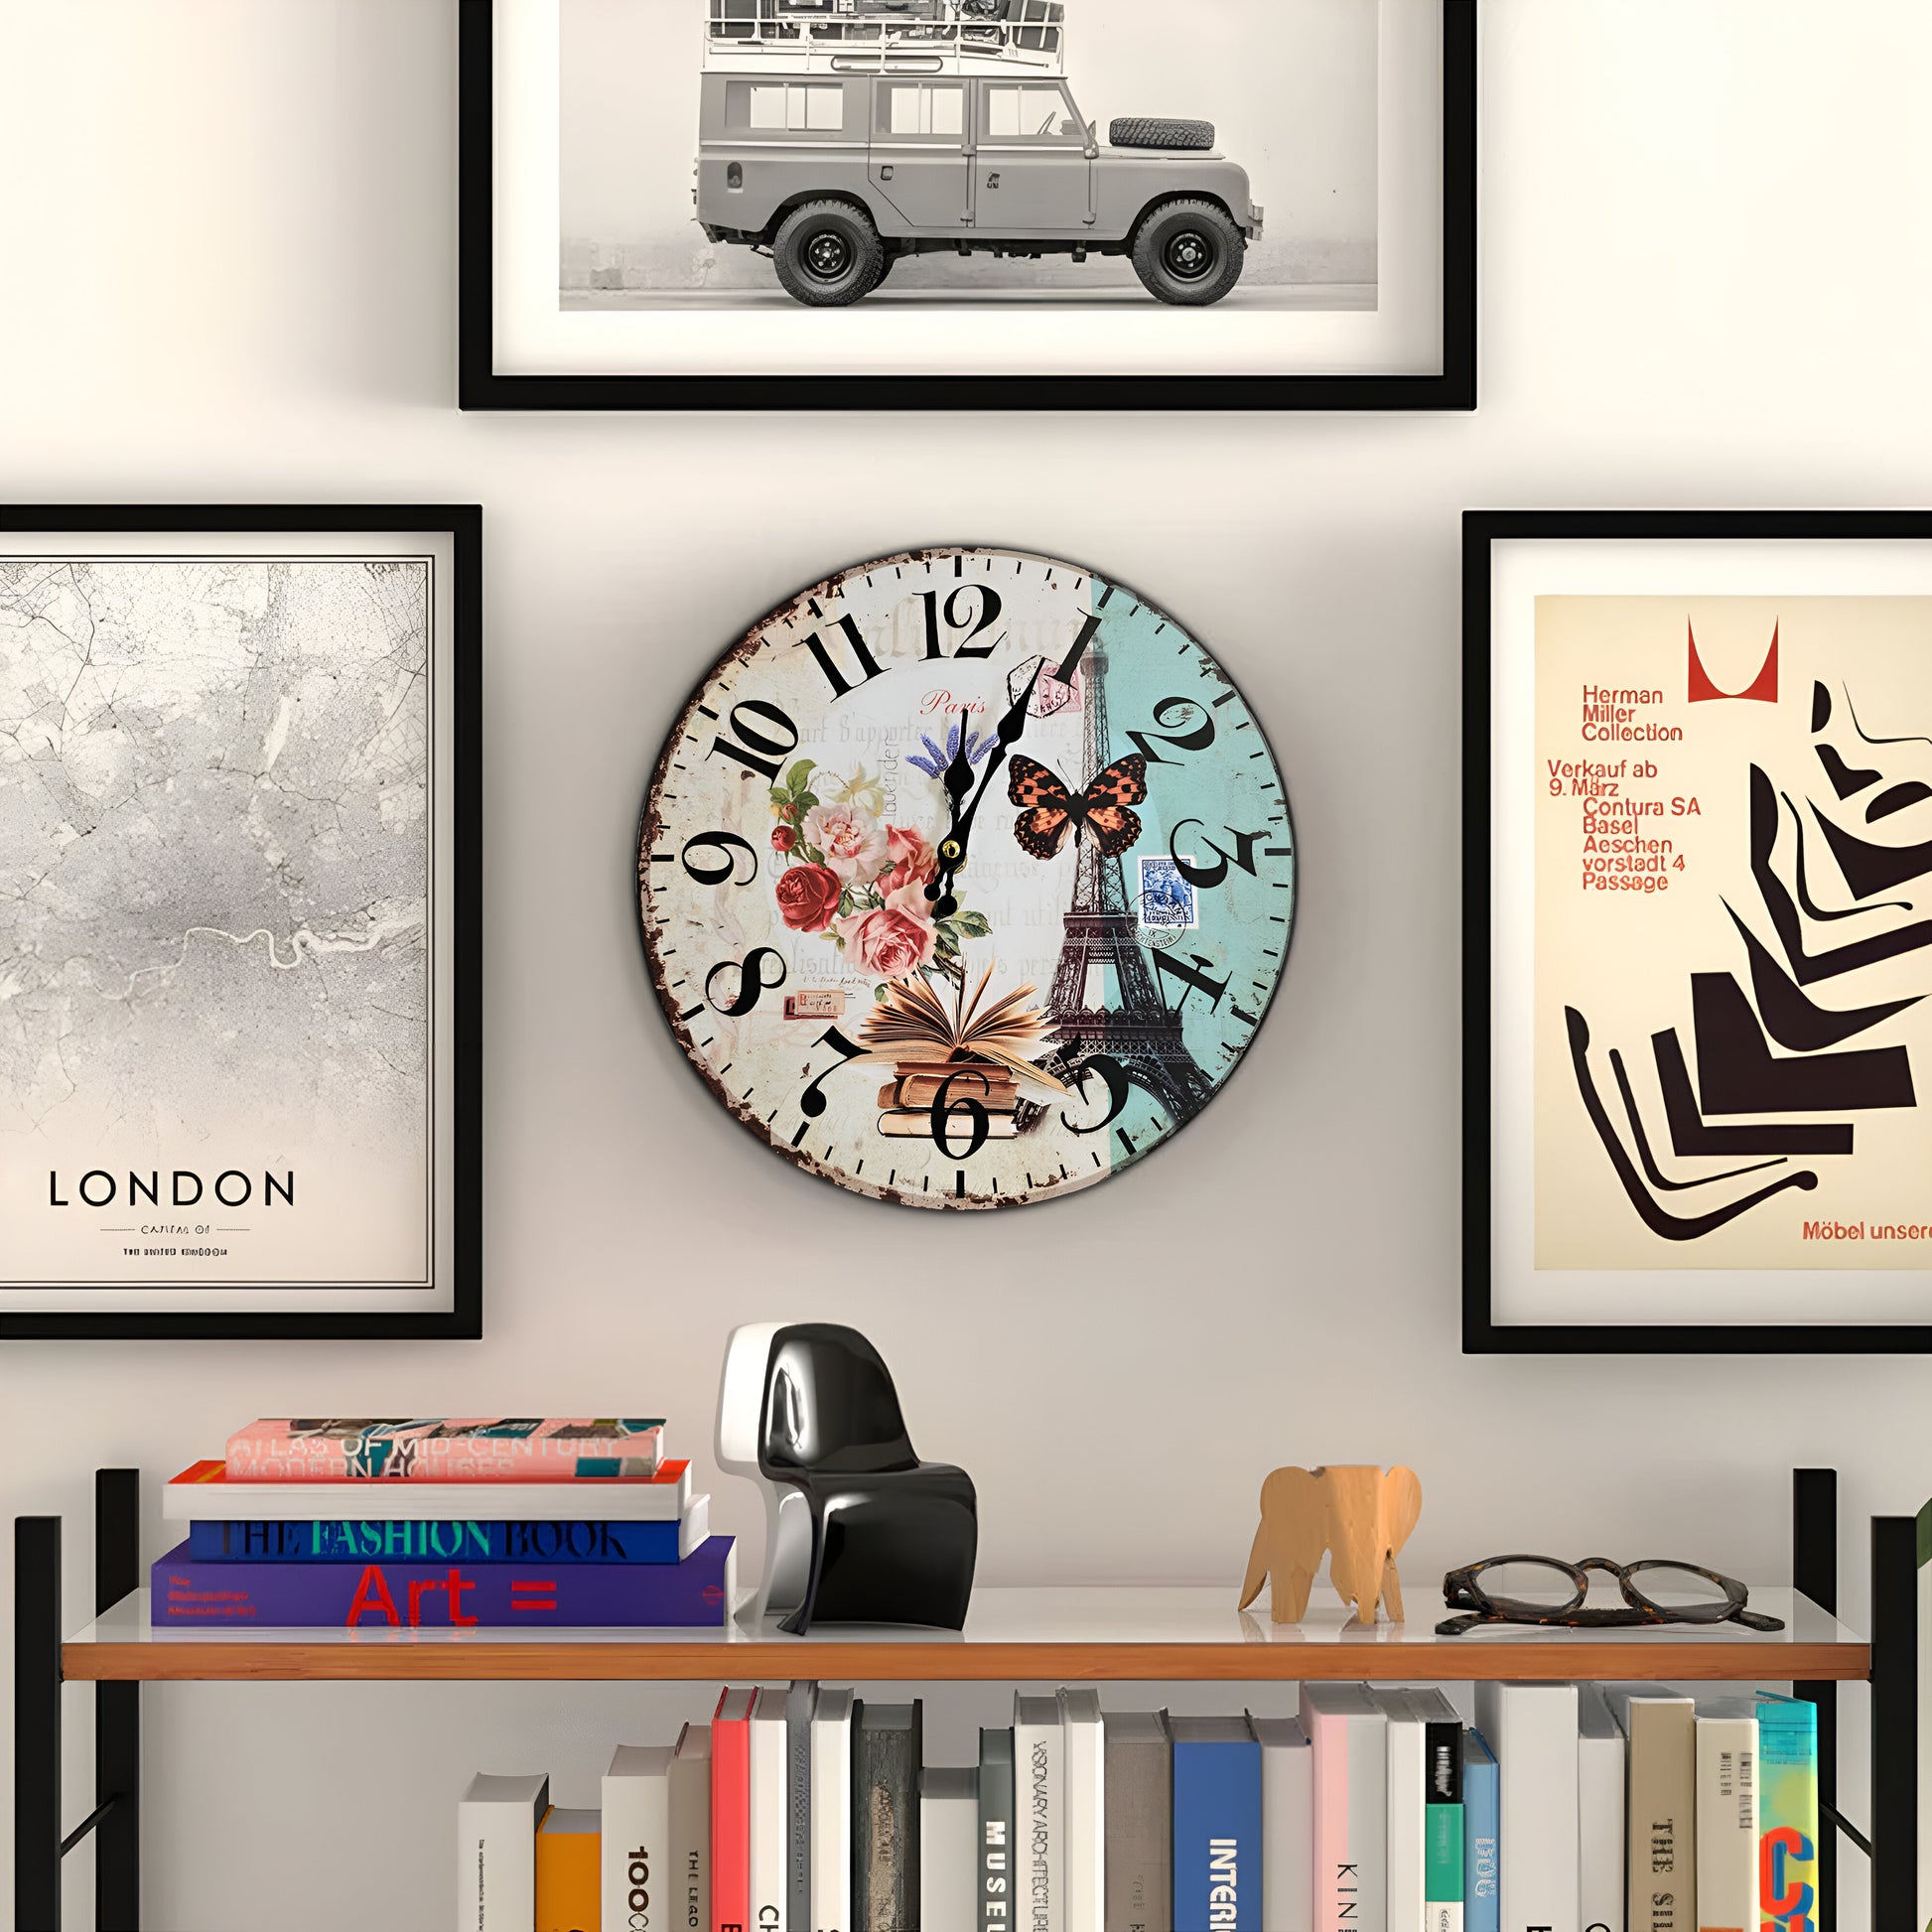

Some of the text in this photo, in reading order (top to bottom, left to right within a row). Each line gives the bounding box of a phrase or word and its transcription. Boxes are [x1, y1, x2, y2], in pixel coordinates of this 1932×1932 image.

[911, 584, 1007, 662] 12
[1042, 607, 1103, 691] 1
[791, 613, 893, 704] 11
[919, 689, 986, 715] Paris
[1583, 685, 1663, 704] Herman
[1583, 704, 1637, 723] Miller
[704, 699, 799, 790] 10
[1125, 696, 1216, 766] 2
[1547, 759, 1658, 778] Verkauf ab
[1549, 777, 1567, 796] 9.
[1583, 796, 1702, 816] Contura SA
[1583, 815, 1638, 835] Basel
[681, 831, 759, 887] 9
[1170, 817, 1257, 889] 3
[1582, 854, 1686, 873] vorstadt 4
[1583, 835, 1673, 854] Aeschen
[1582, 872, 1669, 894] Passage
[704, 946, 787, 1017] 8
[1151, 947, 1233, 1016] 4
[800, 1026, 873, 1118] 7
[1055, 1033, 1130, 1134] 5
[930, 1069, 990, 1161] 6
[50, 1170, 294, 1207] LONDON
[1802, 1221, 1932, 1240] Möbel unser
[341, 1438, 382, 1456] OF
[311, 1520, 490, 1557] FASHION
[504, 1521, 627, 1560] BOOK
[345, 1565, 480, 1627] Art
[1651, 1818, 1675, 1874] THE
[1337, 1863, 1359, 1932] KIN
